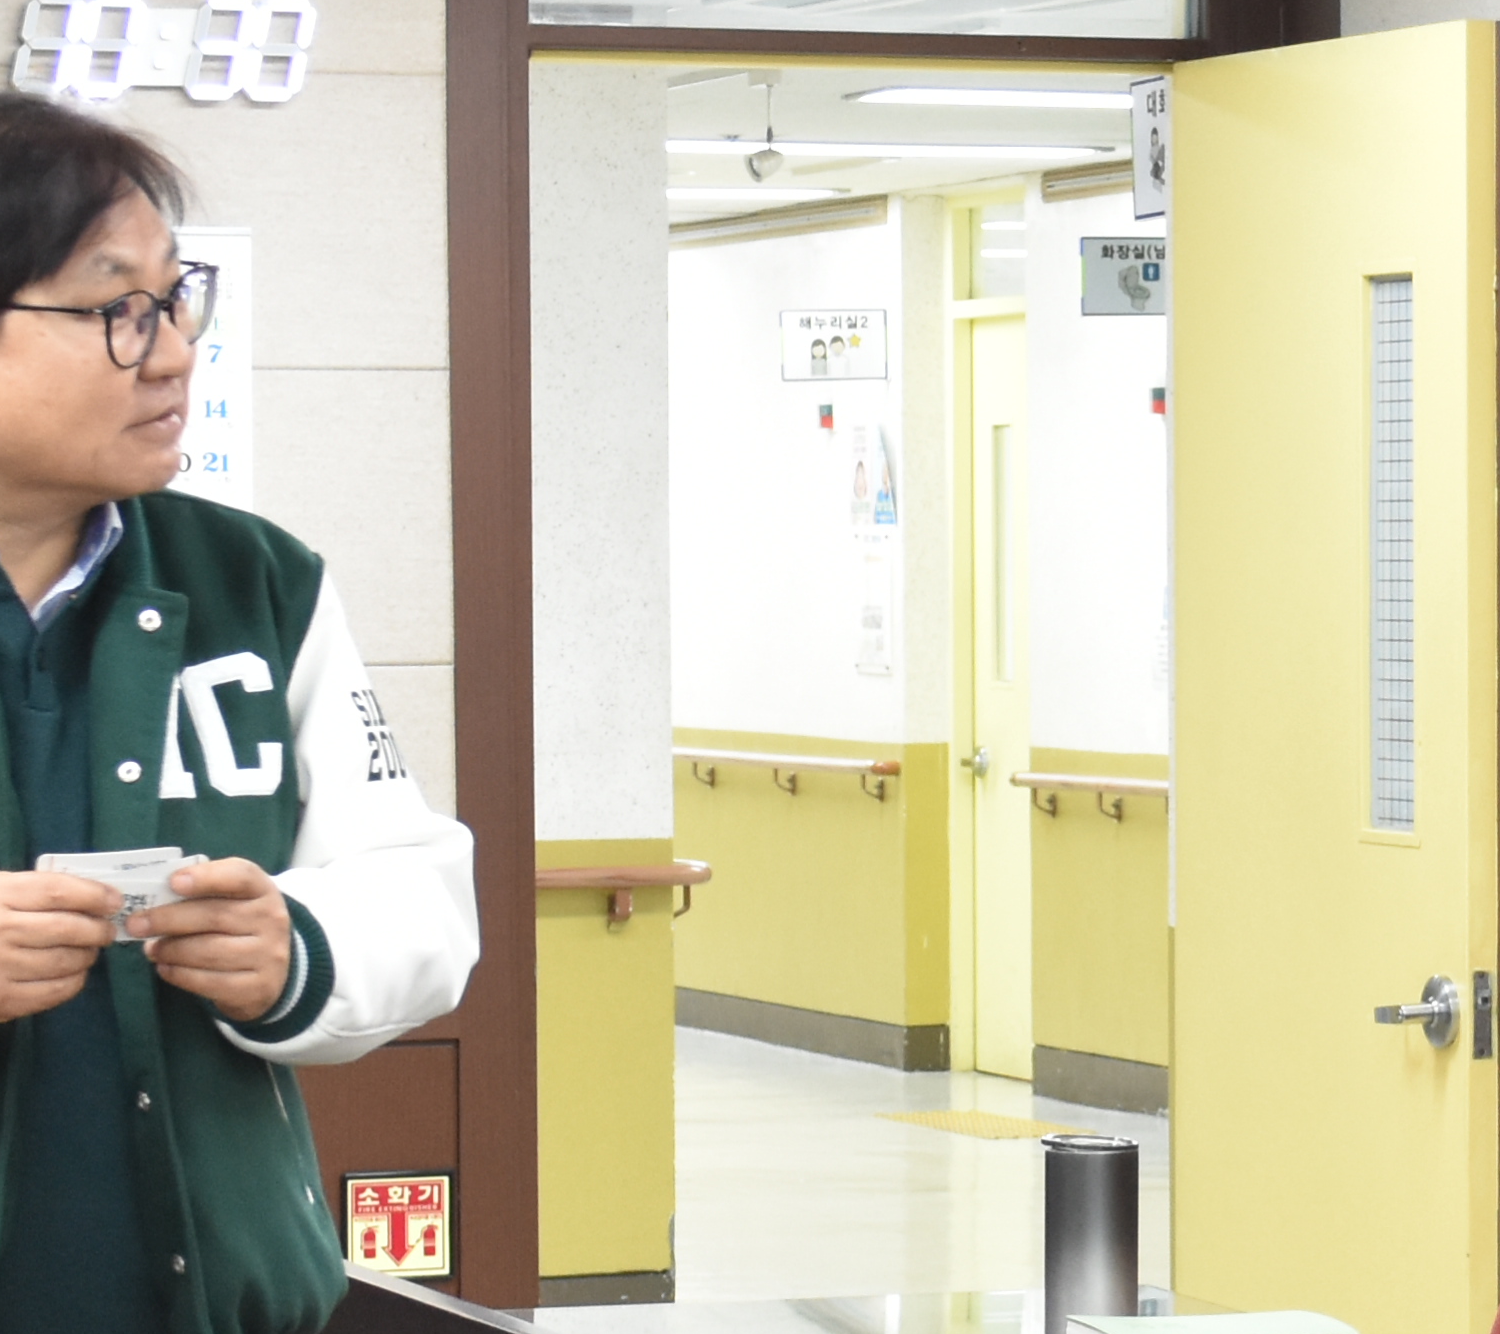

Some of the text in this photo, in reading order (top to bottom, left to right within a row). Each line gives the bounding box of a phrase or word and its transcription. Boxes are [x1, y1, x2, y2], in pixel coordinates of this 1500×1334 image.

[207, 344, 223, 363] 7
[204, 399, 227, 418] 14
[202, 452, 229, 472] 21
